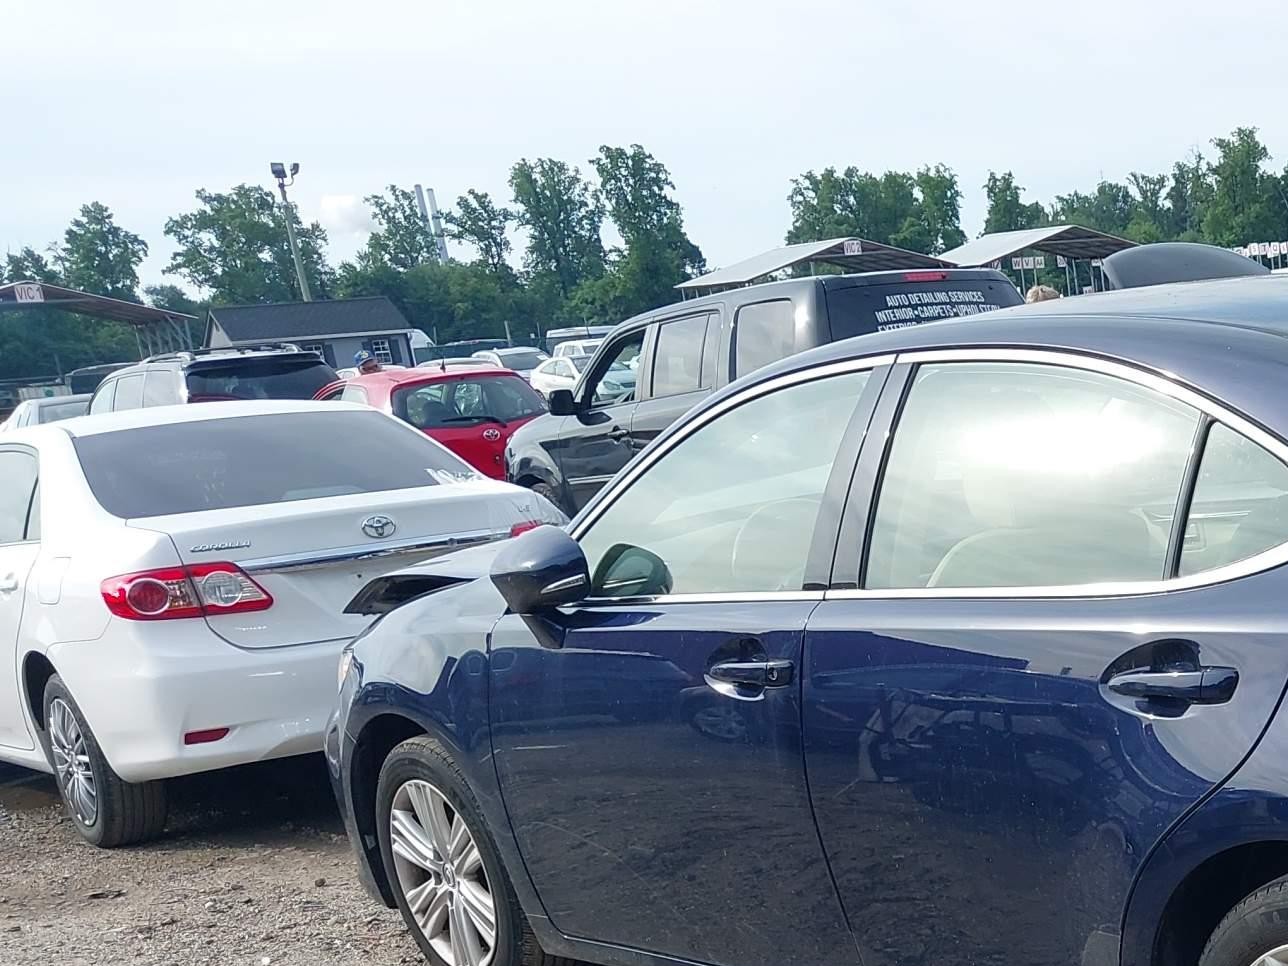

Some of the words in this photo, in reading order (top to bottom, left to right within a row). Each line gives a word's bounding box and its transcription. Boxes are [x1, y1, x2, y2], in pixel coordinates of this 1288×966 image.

[16, 287, 35, 300] VIC
[886, 294, 909, 307] AUTO
[908, 291, 949, 304] DETAILING
[948, 291, 985, 302] SERVICES
[875, 307, 915, 322] INTERIOR
[190, 539, 251, 553] COROLLA
